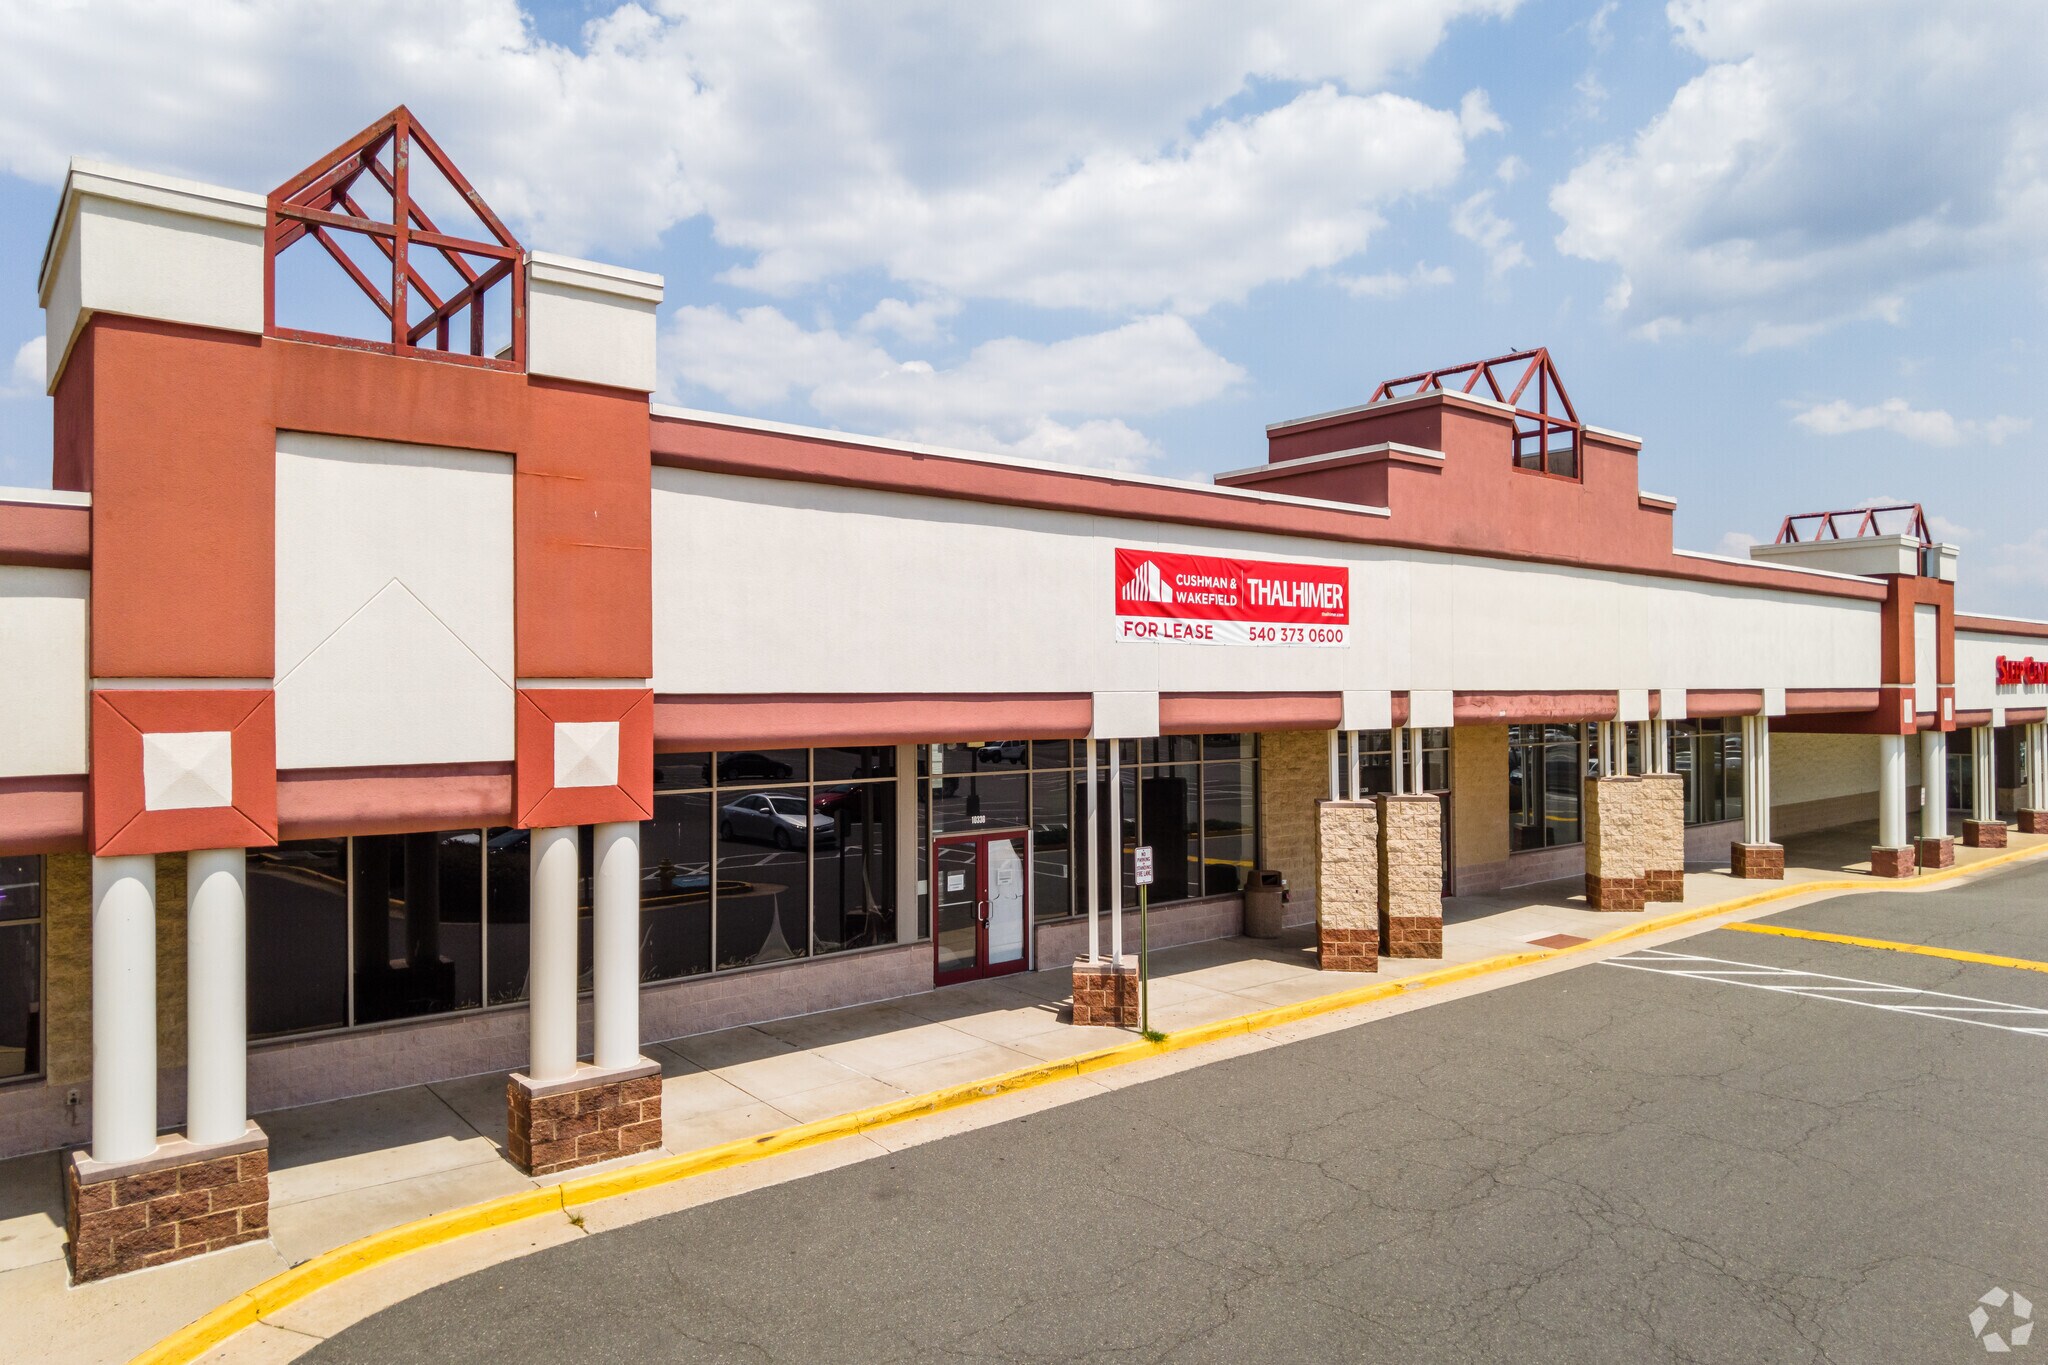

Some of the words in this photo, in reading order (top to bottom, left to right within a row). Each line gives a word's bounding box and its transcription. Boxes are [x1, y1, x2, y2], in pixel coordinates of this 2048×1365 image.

[1176, 574, 1228, 589] CUSHMAN
[1230, 578, 1237, 589] &
[1176, 591, 1238, 607] WAKEFIELD
[1247, 578, 1344, 609] THALHIMER
[1124, 621, 1158, 637] FOR
[1164, 623, 1213, 639] LEASE
[1249, 627, 1276, 641] 540
[1281, 628, 1304, 642] 373
[1309, 629, 1343, 643] 0600
